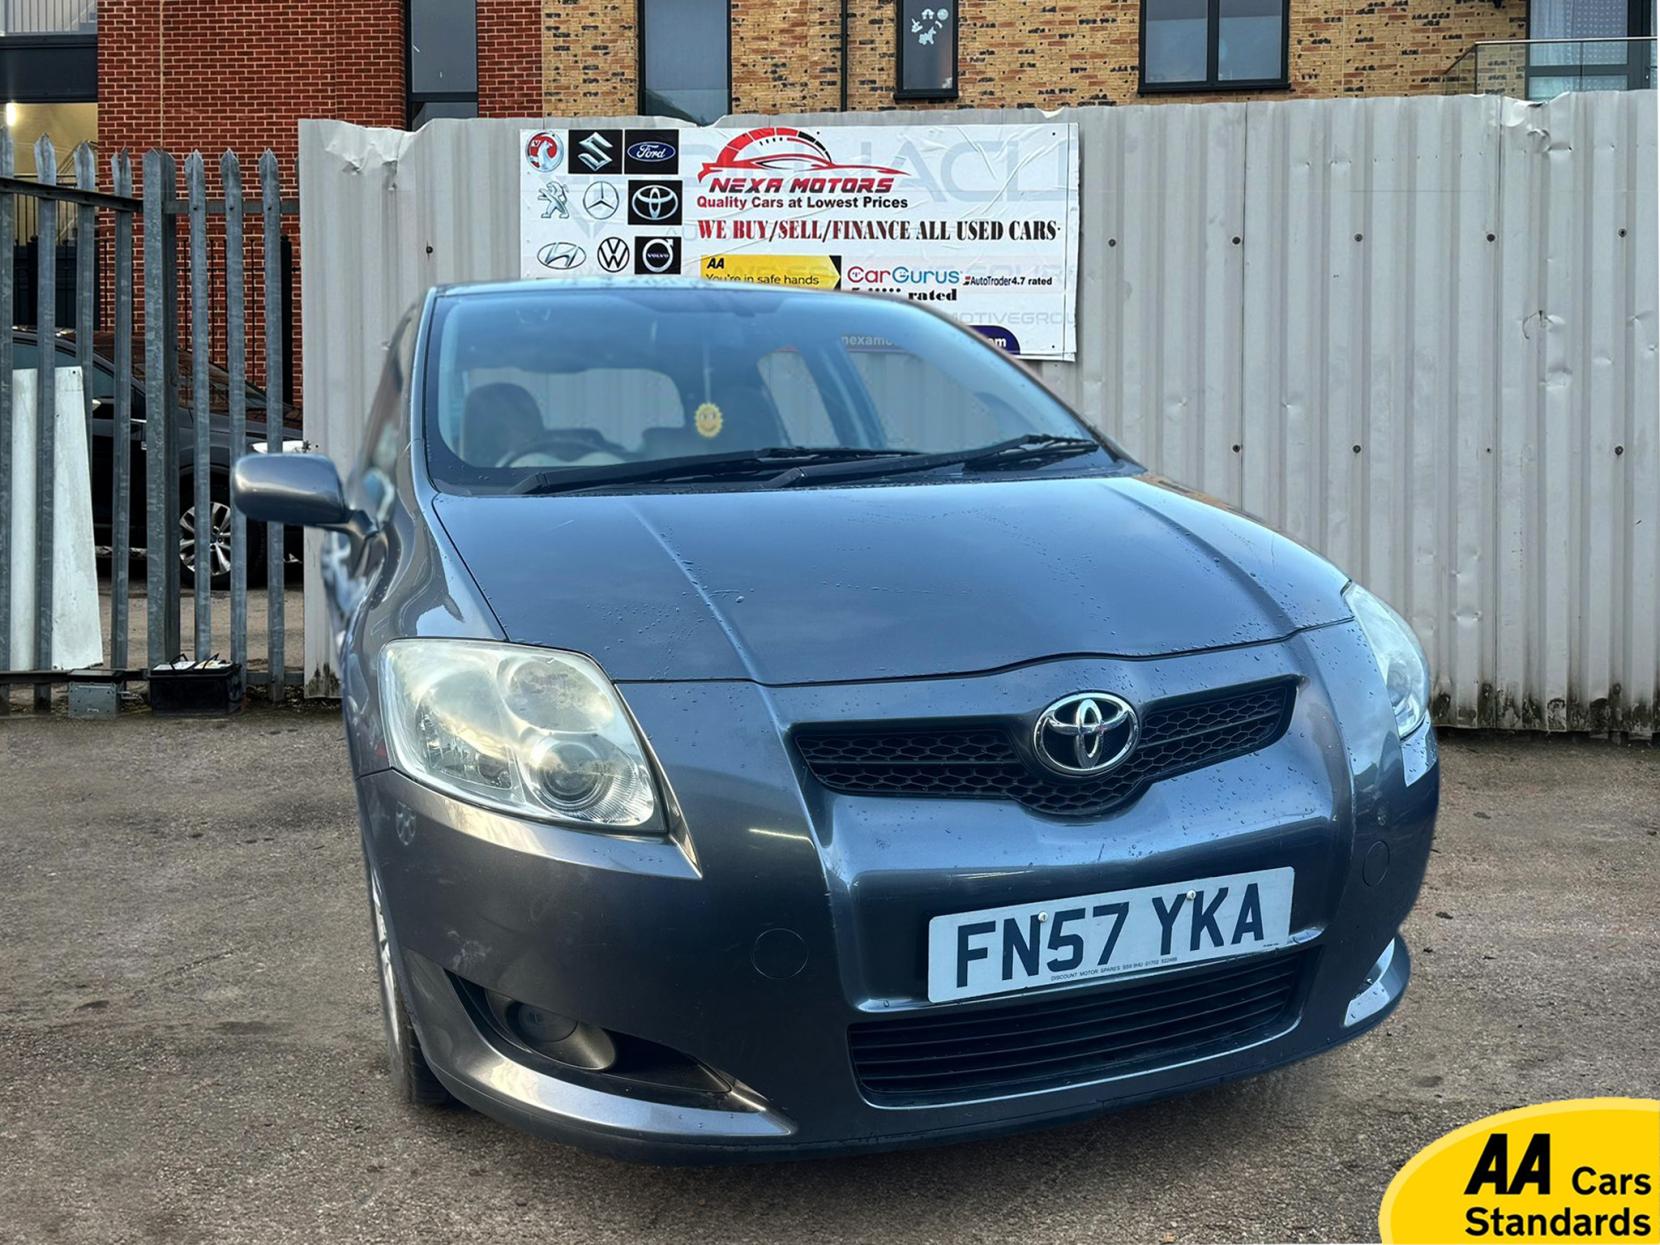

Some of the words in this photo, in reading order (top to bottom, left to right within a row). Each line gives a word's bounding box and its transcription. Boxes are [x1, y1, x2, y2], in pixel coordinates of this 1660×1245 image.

[636, 144, 666, 158] Ford
[709, 178, 783, 193] NEXA
[790, 178, 894, 193] MOTORS
[697, 196, 747, 210] Quality
[752, 196, 784, 208] Cars
[788, 196, 802, 208] at
[807, 196, 858, 208] Lowest
[863, 196, 908, 208] Prices
[698, 220, 726, 239] WE
[733, 220, 910, 242] BUY/SELL/FINANCE
[916, 221, 950, 240] ALL
[957, 221, 1003, 240] USED
[1009, 221, 1057, 240] CARS
[706, 258, 725, 269] AA
[744, 274, 755, 283] in
[757, 275, 781, 285] safe
[784, 275, 819, 285] hands
[847, 266, 960, 284] CarGurus
[1028, 277, 1053, 285] rated
[908, 288, 957, 301] rated
[956, 901, 1129, 988] FN57
[1152, 883, 1265, 956] YKA
[1051, 972, 1078, 981] DISCOUNT
[1080, 969, 1099, 977] MOTOR
